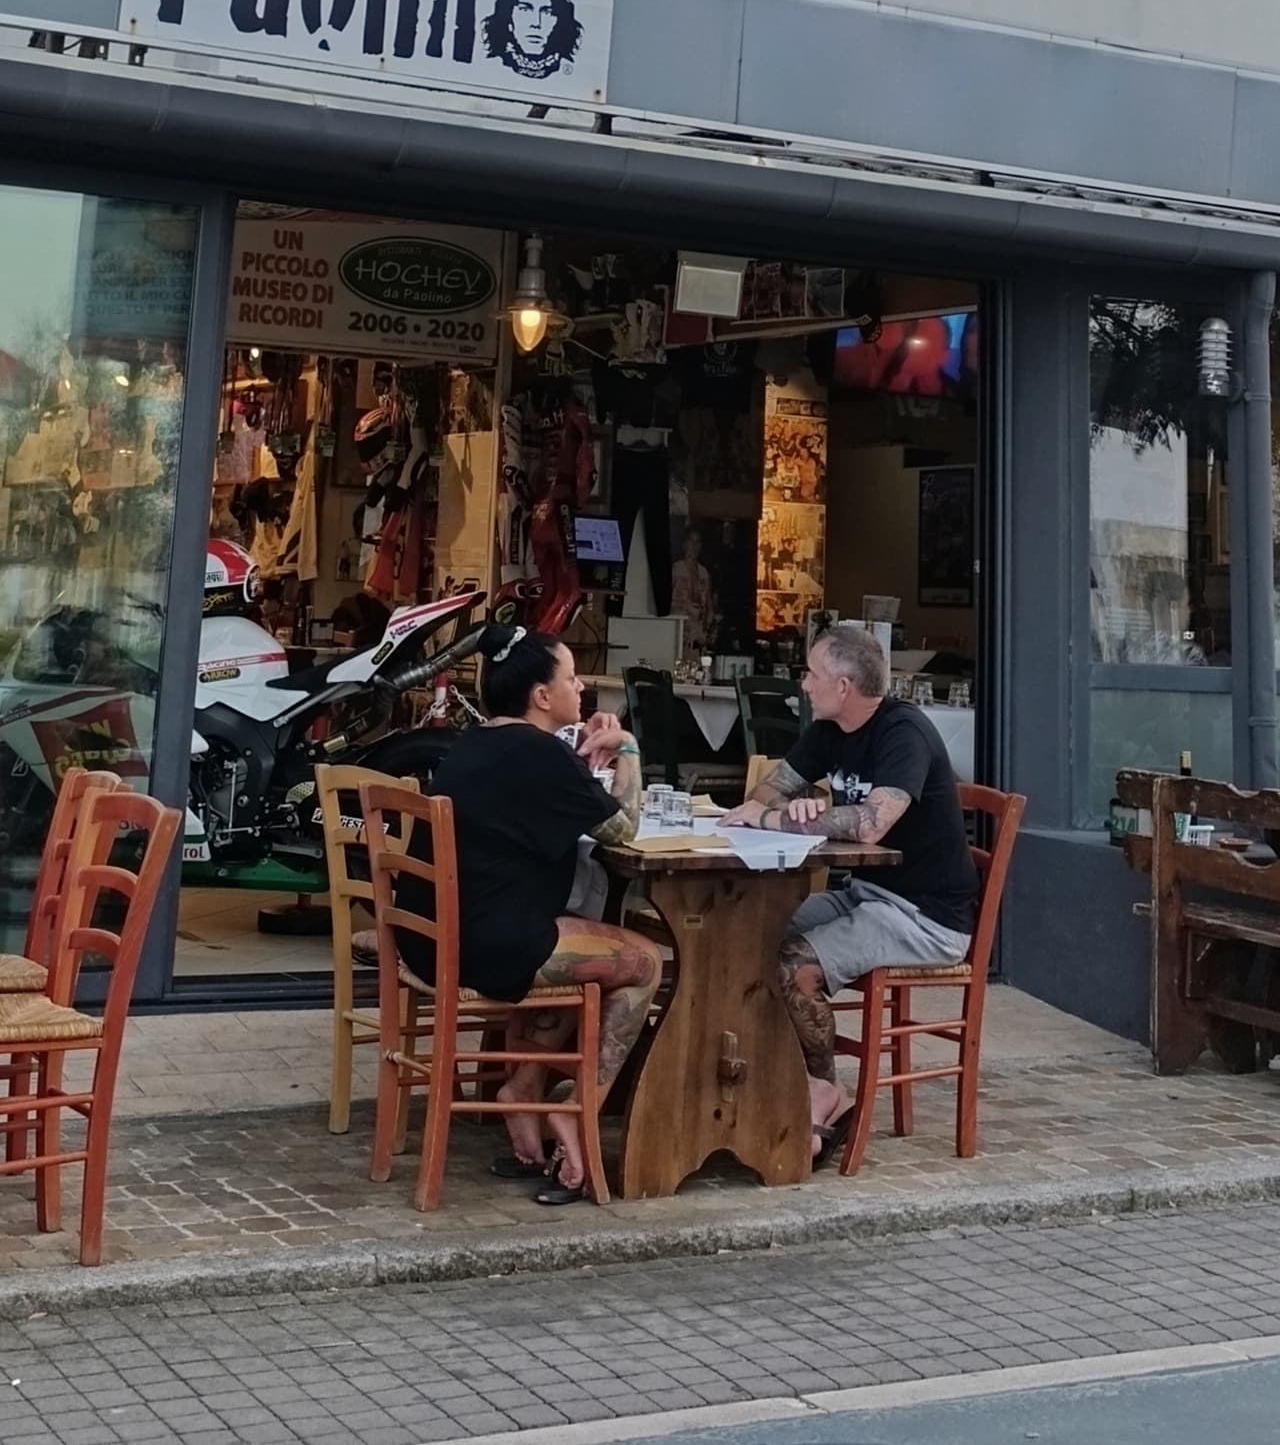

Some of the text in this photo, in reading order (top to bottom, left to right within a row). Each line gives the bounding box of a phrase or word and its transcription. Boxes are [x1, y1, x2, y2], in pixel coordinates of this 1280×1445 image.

[273, 229, 304, 251] UN
[241, 251, 329, 279] PICCOLO
[232, 276, 334, 305] MUSEO DI
[383, 287, 452, 305] da Paolino
[238, 302, 324, 330] RICORDI
[348, 312, 485, 341] 2006 2020
